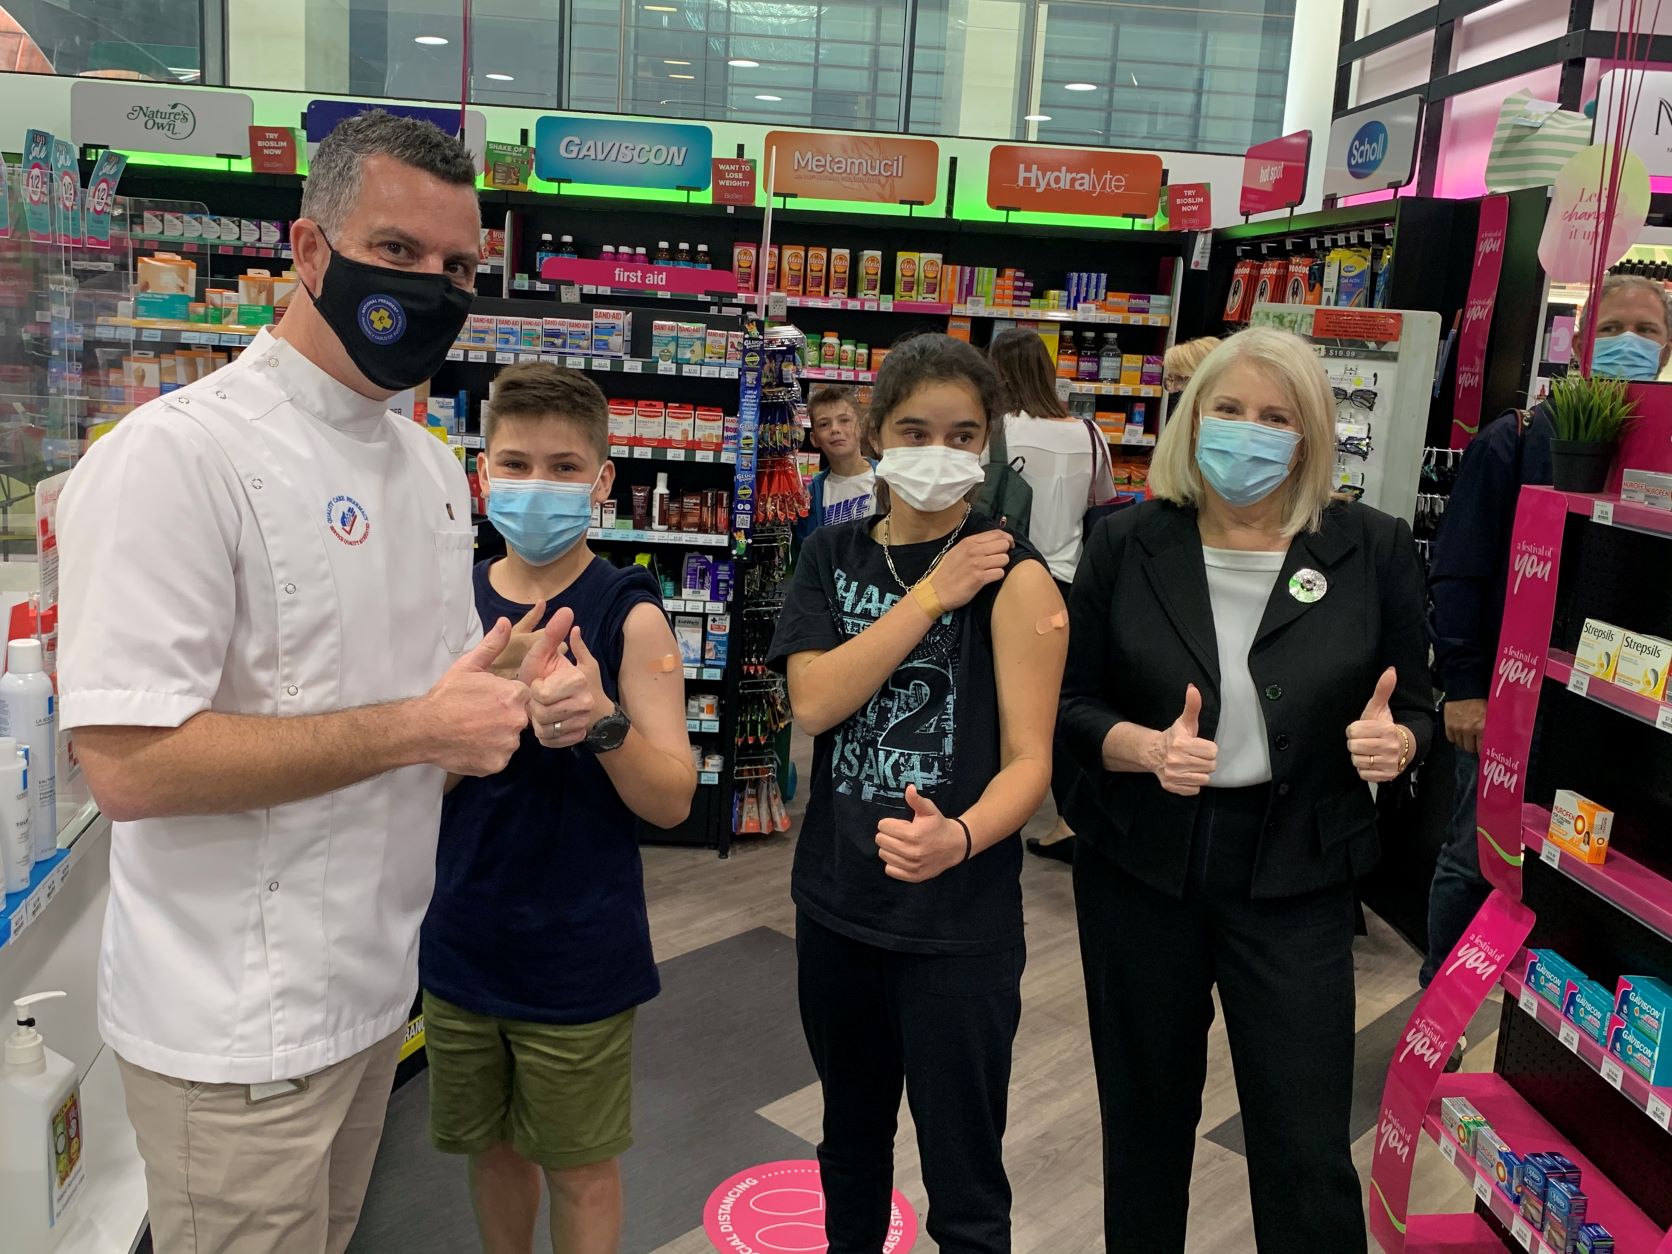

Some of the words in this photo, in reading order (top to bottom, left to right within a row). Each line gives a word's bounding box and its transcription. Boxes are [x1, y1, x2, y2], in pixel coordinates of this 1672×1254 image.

[127, 105, 189, 123] Nature's
[144, 118, 177, 135] Own
[488, 143, 512, 152] SHAKE
[513, 146, 528, 154] OFF
[559, 135, 688, 167] GAVISCON
[1351, 136, 1385, 165] Scholl
[718, 163, 740, 171] WANT
[793, 150, 904, 177] Metamucil
[1260, 165, 1270, 183] hot
[1270, 161, 1284, 183] spot
[718, 179, 750, 187] WEIGHT?
[1017, 163, 1126, 197] Hydralyte
[1176, 197, 1204, 205] BIOSLIM
[1478, 237, 1502, 267] you
[614, 268, 643, 284] first
[646, 270, 666, 286] aid
[595, 311, 622, 320] BAND-AID
[1465, 304, 1489, 334] you
[1328, 349, 1356, 357] $19.99
[1459, 373, 1479, 399] you
[333, 495, 345, 503] CARE
[346, 496, 368, 521] PHARMACY
[823, 493, 872, 526] NIKE
[1521, 540, 1544, 556] festival
[1514, 552, 1552, 594] you
[1584, 622, 1615, 642] Strepsils
[1509, 645, 1531, 664] festival
[1530, 655, 1539, 666] of
[1624, 636, 1662, 659] Strepsils
[1495, 657, 1537, 698] you
[1490, 747, 1513, 767] festival
[1483, 759, 1518, 799] you
[1474, 932, 1498, 959] festival
[1446, 943, 1498, 981] you
[1536, 963, 1562, 986] GAVISCON
[1576, 994, 1602, 1019] GAVISCON
[1629, 992, 1661, 1019] GAVISCON
[1419, 1016, 1441, 1046] festival
[1622, 1030, 1654, 1058] GAVISCON
[1399, 1027, 1443, 1070] you
[1388, 1109, 1406, 1137] festival
[1379, 1118, 1410, 1164] you
[718, 1177, 759, 1232] DISTANCING
